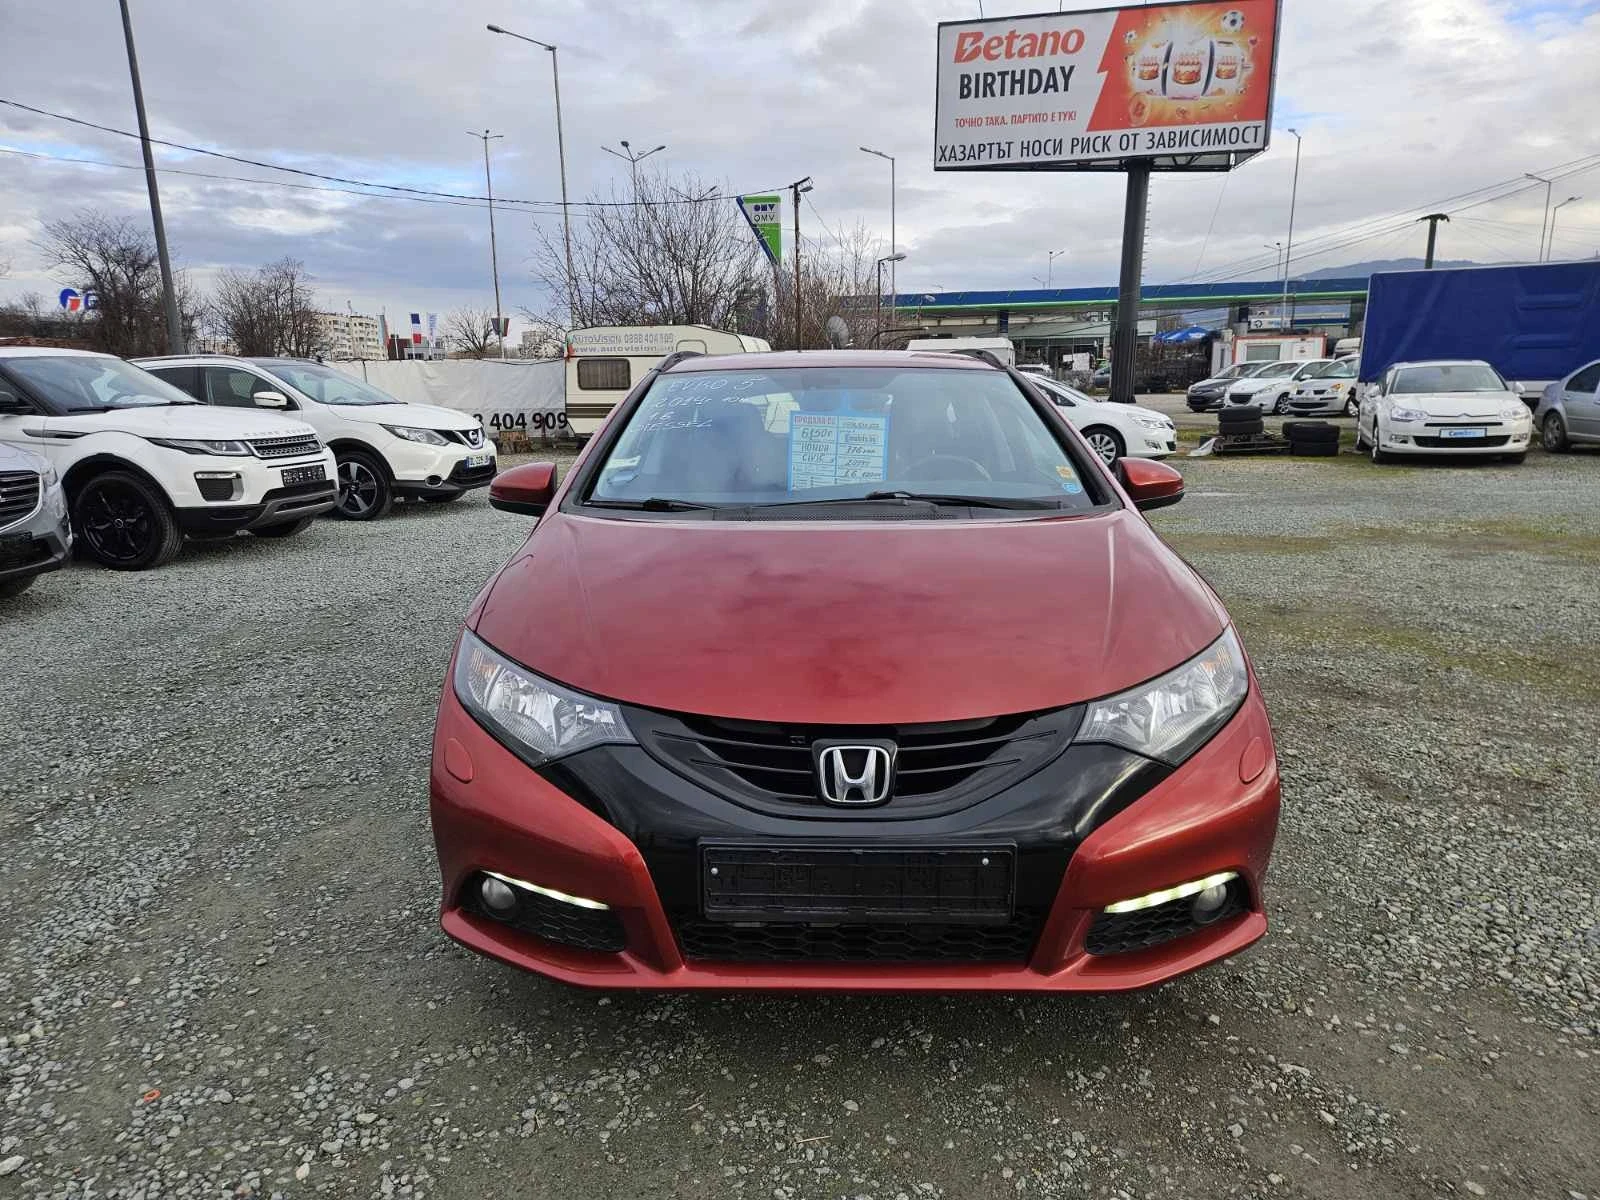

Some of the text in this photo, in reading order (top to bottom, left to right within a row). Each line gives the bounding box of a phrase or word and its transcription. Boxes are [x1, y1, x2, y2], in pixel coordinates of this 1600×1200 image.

[954, 28, 1086, 63] Betano
[959, 65, 1076, 99] BIRTHDAY
[955, 117, 983, 128] ТОЧНО
[1010, 113, 1048, 125] ПАРТИТО
[1058, 111, 1077, 122] ТУК!
[938, 125, 1263, 162] ХАЗАРТЪТ НОСИ РИСК ОТ ЗАВИСИМОСТ
[753, 214, 775, 222] OMV
[489, 412, 527, 431] 404
[532, 411, 568, 430] 909
